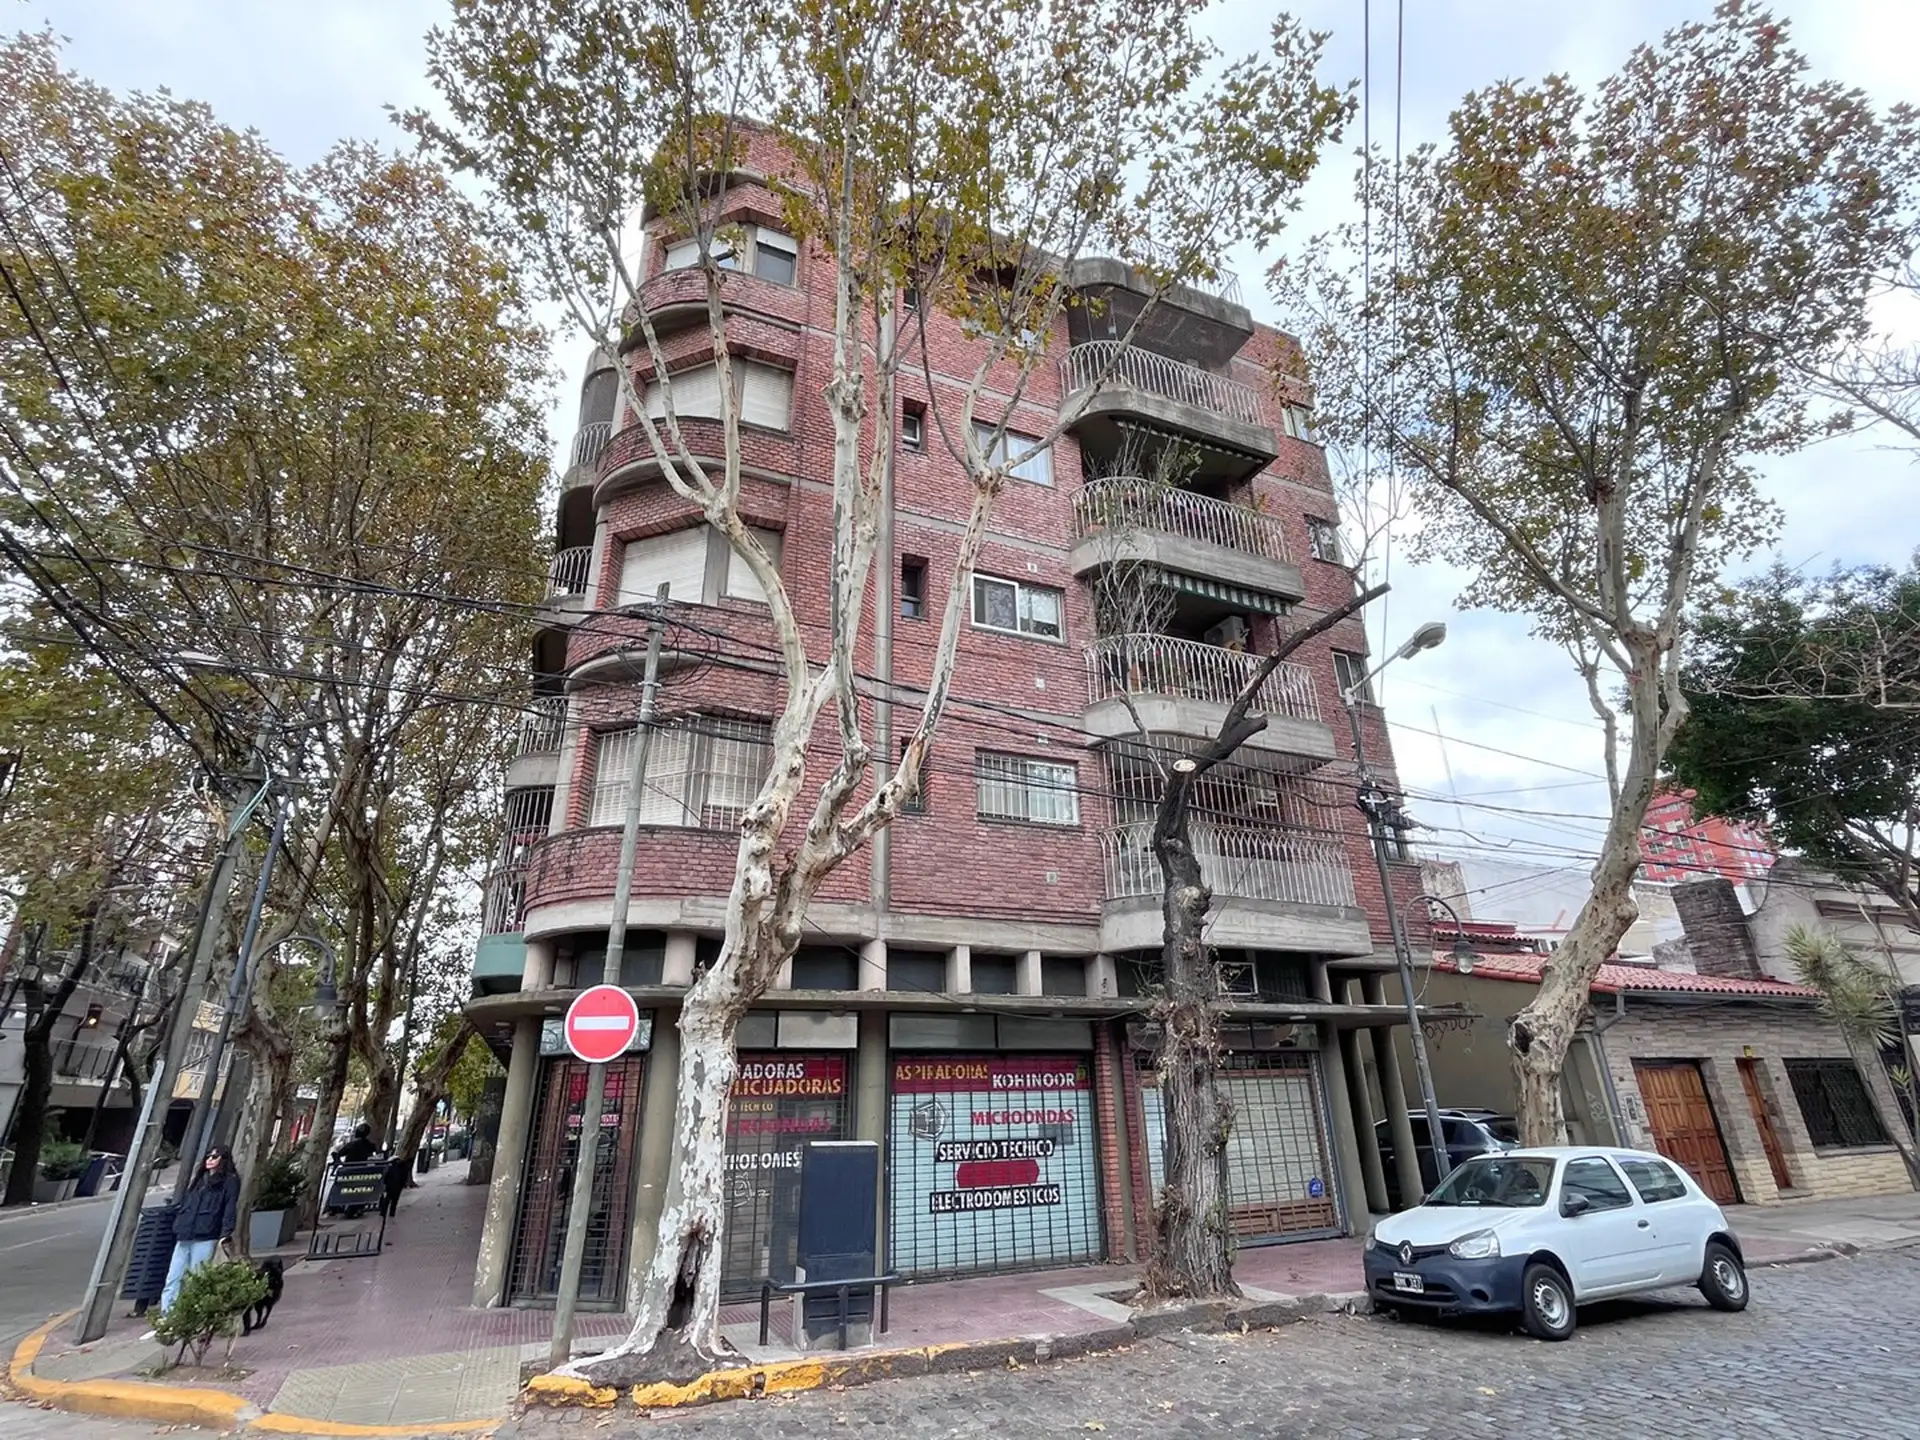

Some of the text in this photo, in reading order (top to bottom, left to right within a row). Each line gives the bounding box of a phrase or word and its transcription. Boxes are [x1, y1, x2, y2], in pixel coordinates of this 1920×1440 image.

[737, 1063, 804, 1079] ADORAS
[992, 1072, 1076, 1089] KOHINOOR
[971, 1108, 1075, 1126] MICROONDAS
[938, 1138, 1053, 1161] SERVICIO TECNICO
[931, 1186, 1060, 1212] ELECTRODOMESTICOS
